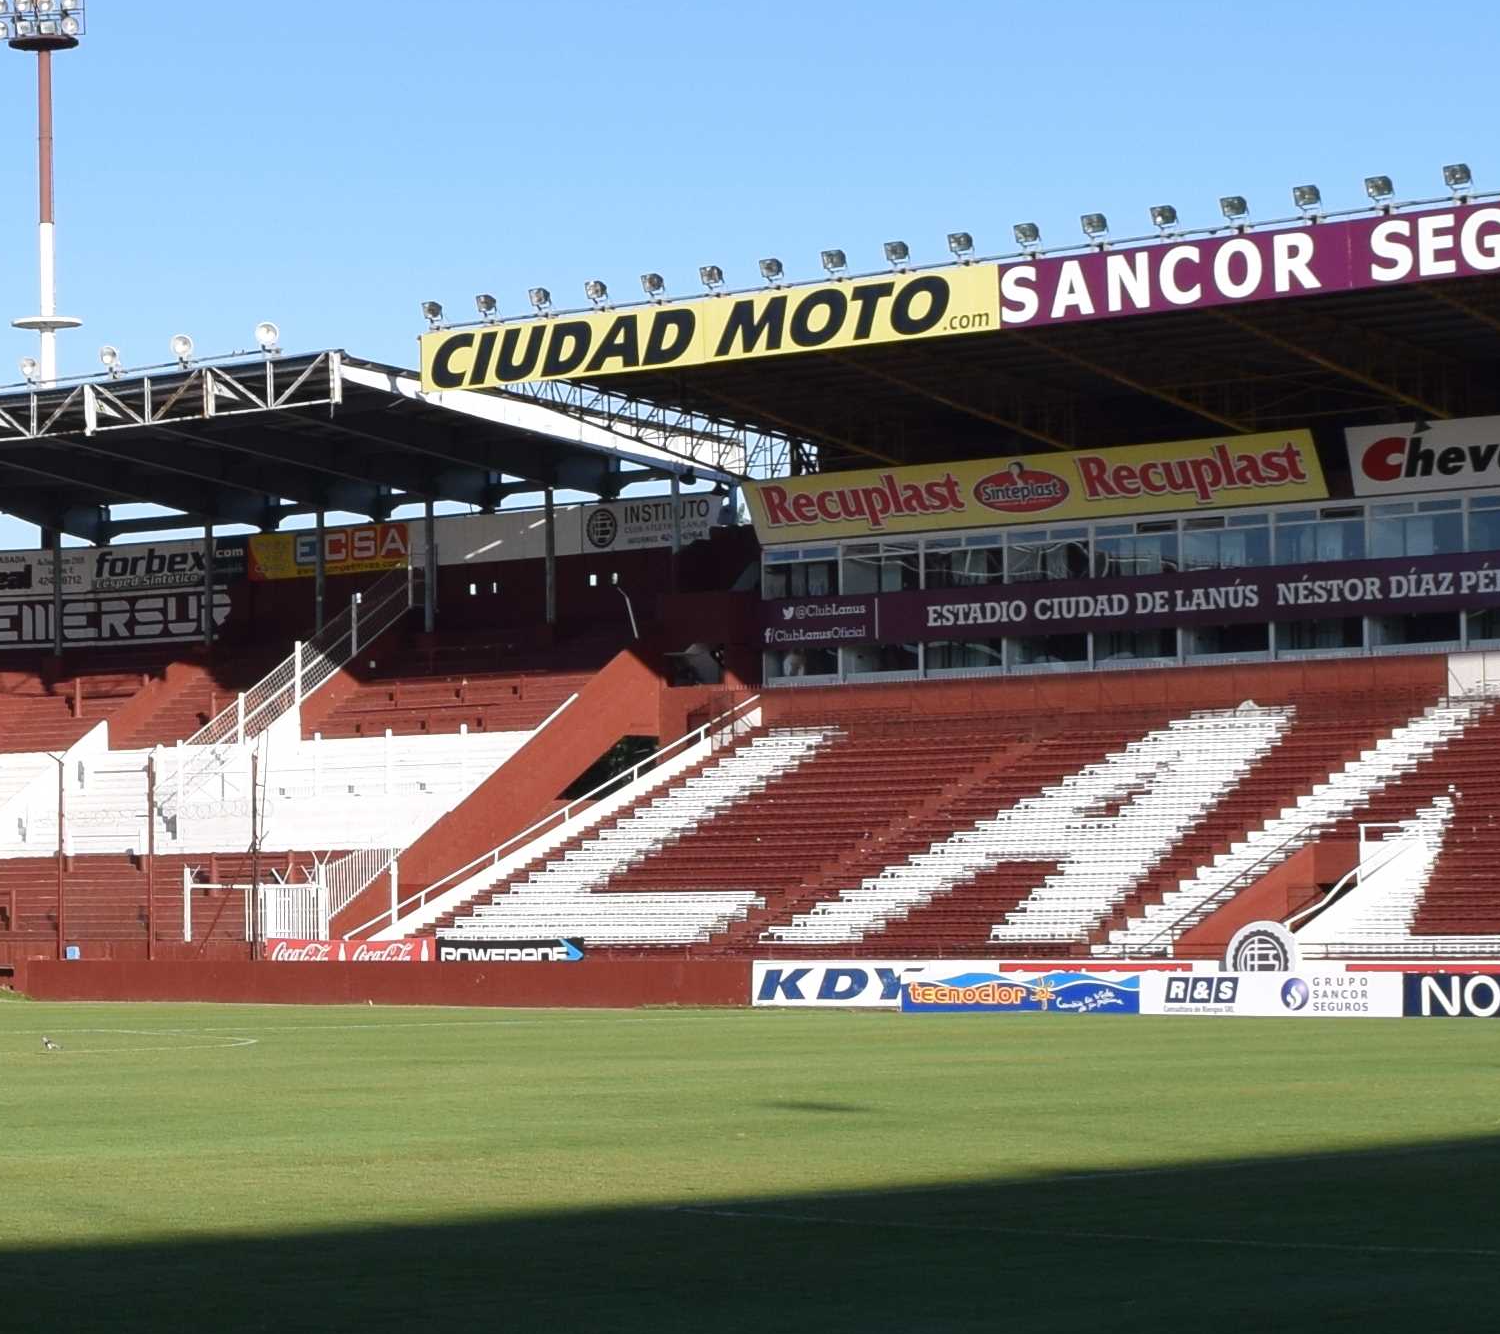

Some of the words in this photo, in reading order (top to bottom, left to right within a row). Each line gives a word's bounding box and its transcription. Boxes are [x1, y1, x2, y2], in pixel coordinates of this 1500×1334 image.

[1001, 232, 1321, 323] SANCOR
[431, 309, 695, 388] CIUDAD
[1076, 443, 1306, 501] Recuplast
[761, 473, 965, 528] Recuplast
[982, 482, 1062, 505] Sinteplast
[95, 546, 206, 578] forbex
[296, 527, 407, 564] ECSA
[926, 599, 1026, 627] ESTADIO
[1034, 593, 1129, 620] CIUDAD
[1136, 590, 1169, 613] DE
[1176, 578, 1259, 611] LANÚS
[1276, 574, 1382, 606] NÉSTOR
[1389, 566, 1453, 597] DÍAZ
[757, 967, 925, 1001] KDY
[908, 981, 1026, 1005] tecnoclor
[1312, 977, 1368, 987] GRUPO
[1312, 989, 1369, 999] SANCOR
[1312, 1002, 1369, 1012] SEGUROS
